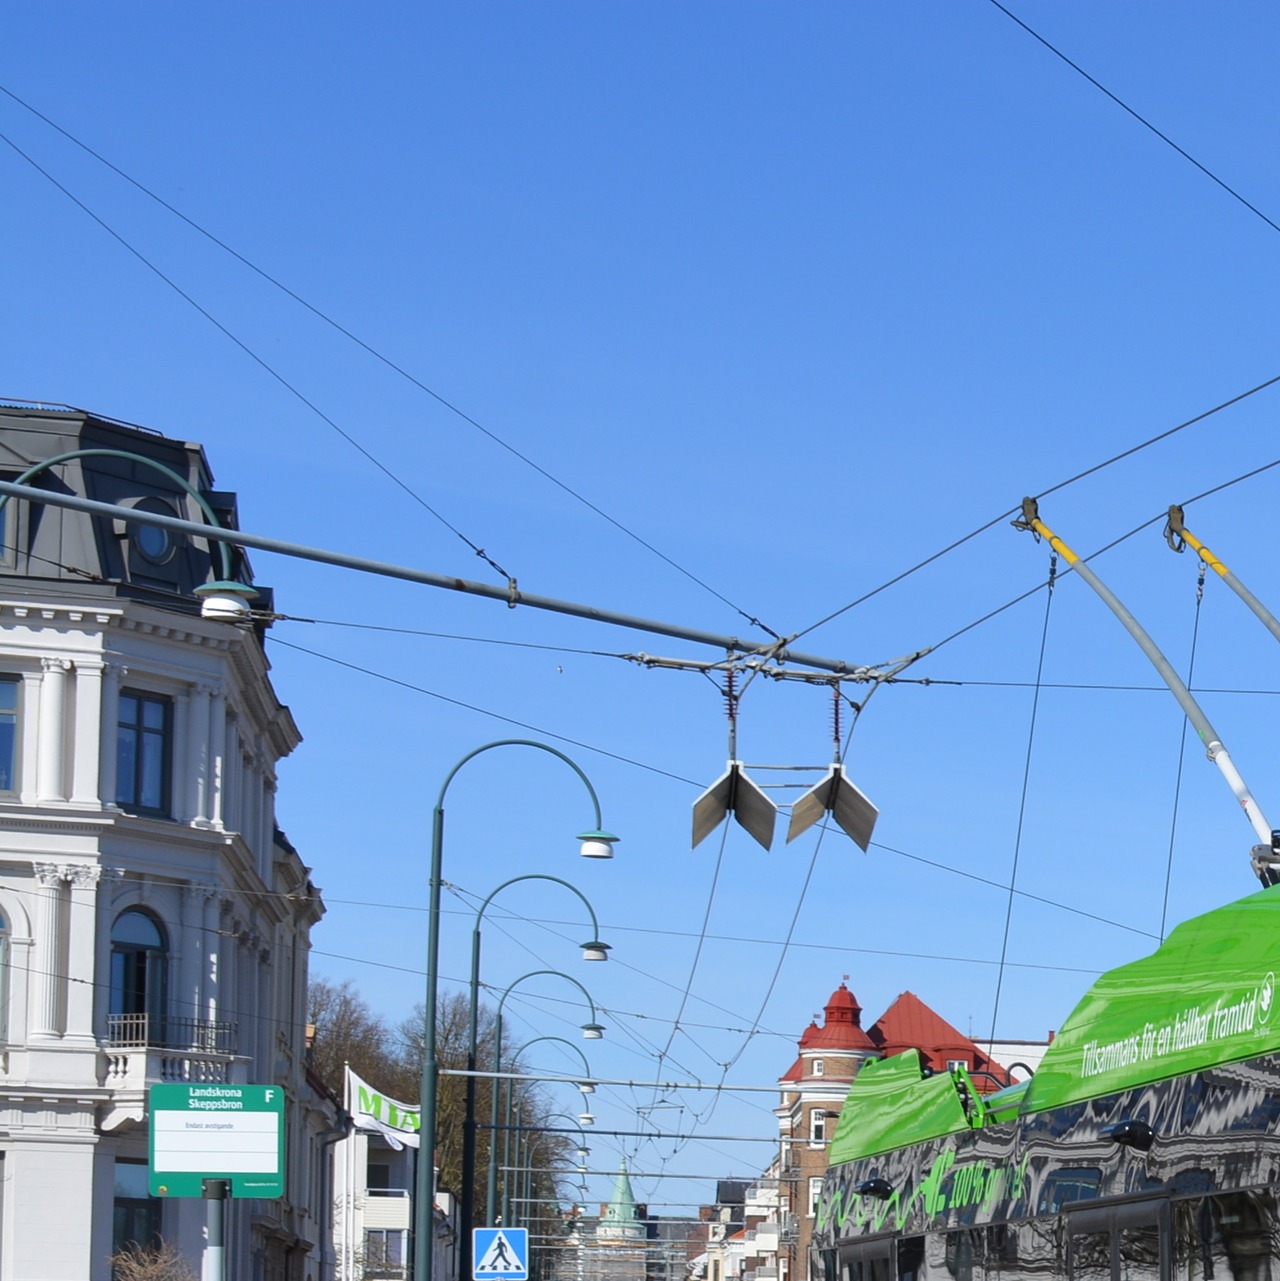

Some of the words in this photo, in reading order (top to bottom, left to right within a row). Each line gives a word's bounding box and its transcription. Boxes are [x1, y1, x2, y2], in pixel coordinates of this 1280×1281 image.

[1081, 1034, 1139, 1079] Tillsammans
[1141, 1022, 1158, 1061] för
[1157, 1027, 1172, 1056] en
[1172, 1006, 1212, 1052] hållbar
[1212, 987, 1259, 1041] framtid
[188, 1086, 243, 1098] Landskrona
[264, 1089, 275, 1103] F
[188, 1098, 244, 1110] Skeppsbron
[948, 1160, 986, 1209] 100%
